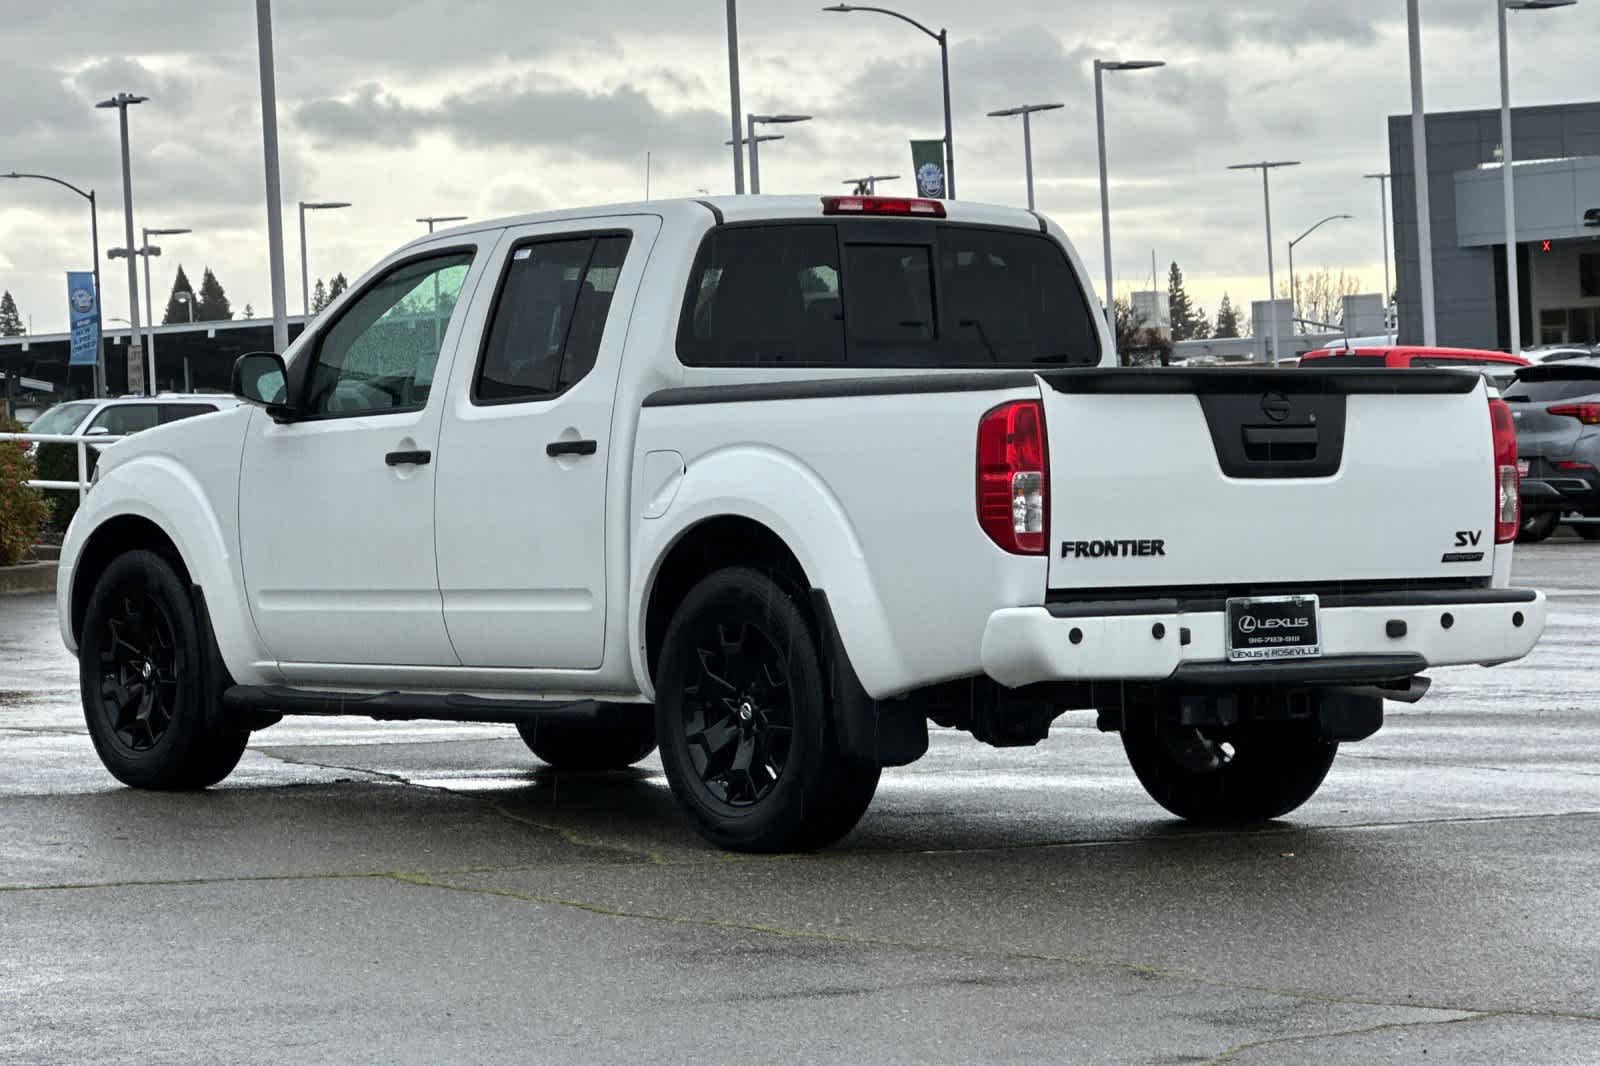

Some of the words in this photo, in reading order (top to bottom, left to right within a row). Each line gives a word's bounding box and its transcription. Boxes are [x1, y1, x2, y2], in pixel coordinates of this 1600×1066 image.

[1454, 529, 1482, 547] SV
[1061, 539, 1166, 558] FRONTIER
[1257, 617, 1309, 629] LEXUS
[1271, 647, 1320, 657] ROSEVILLE
